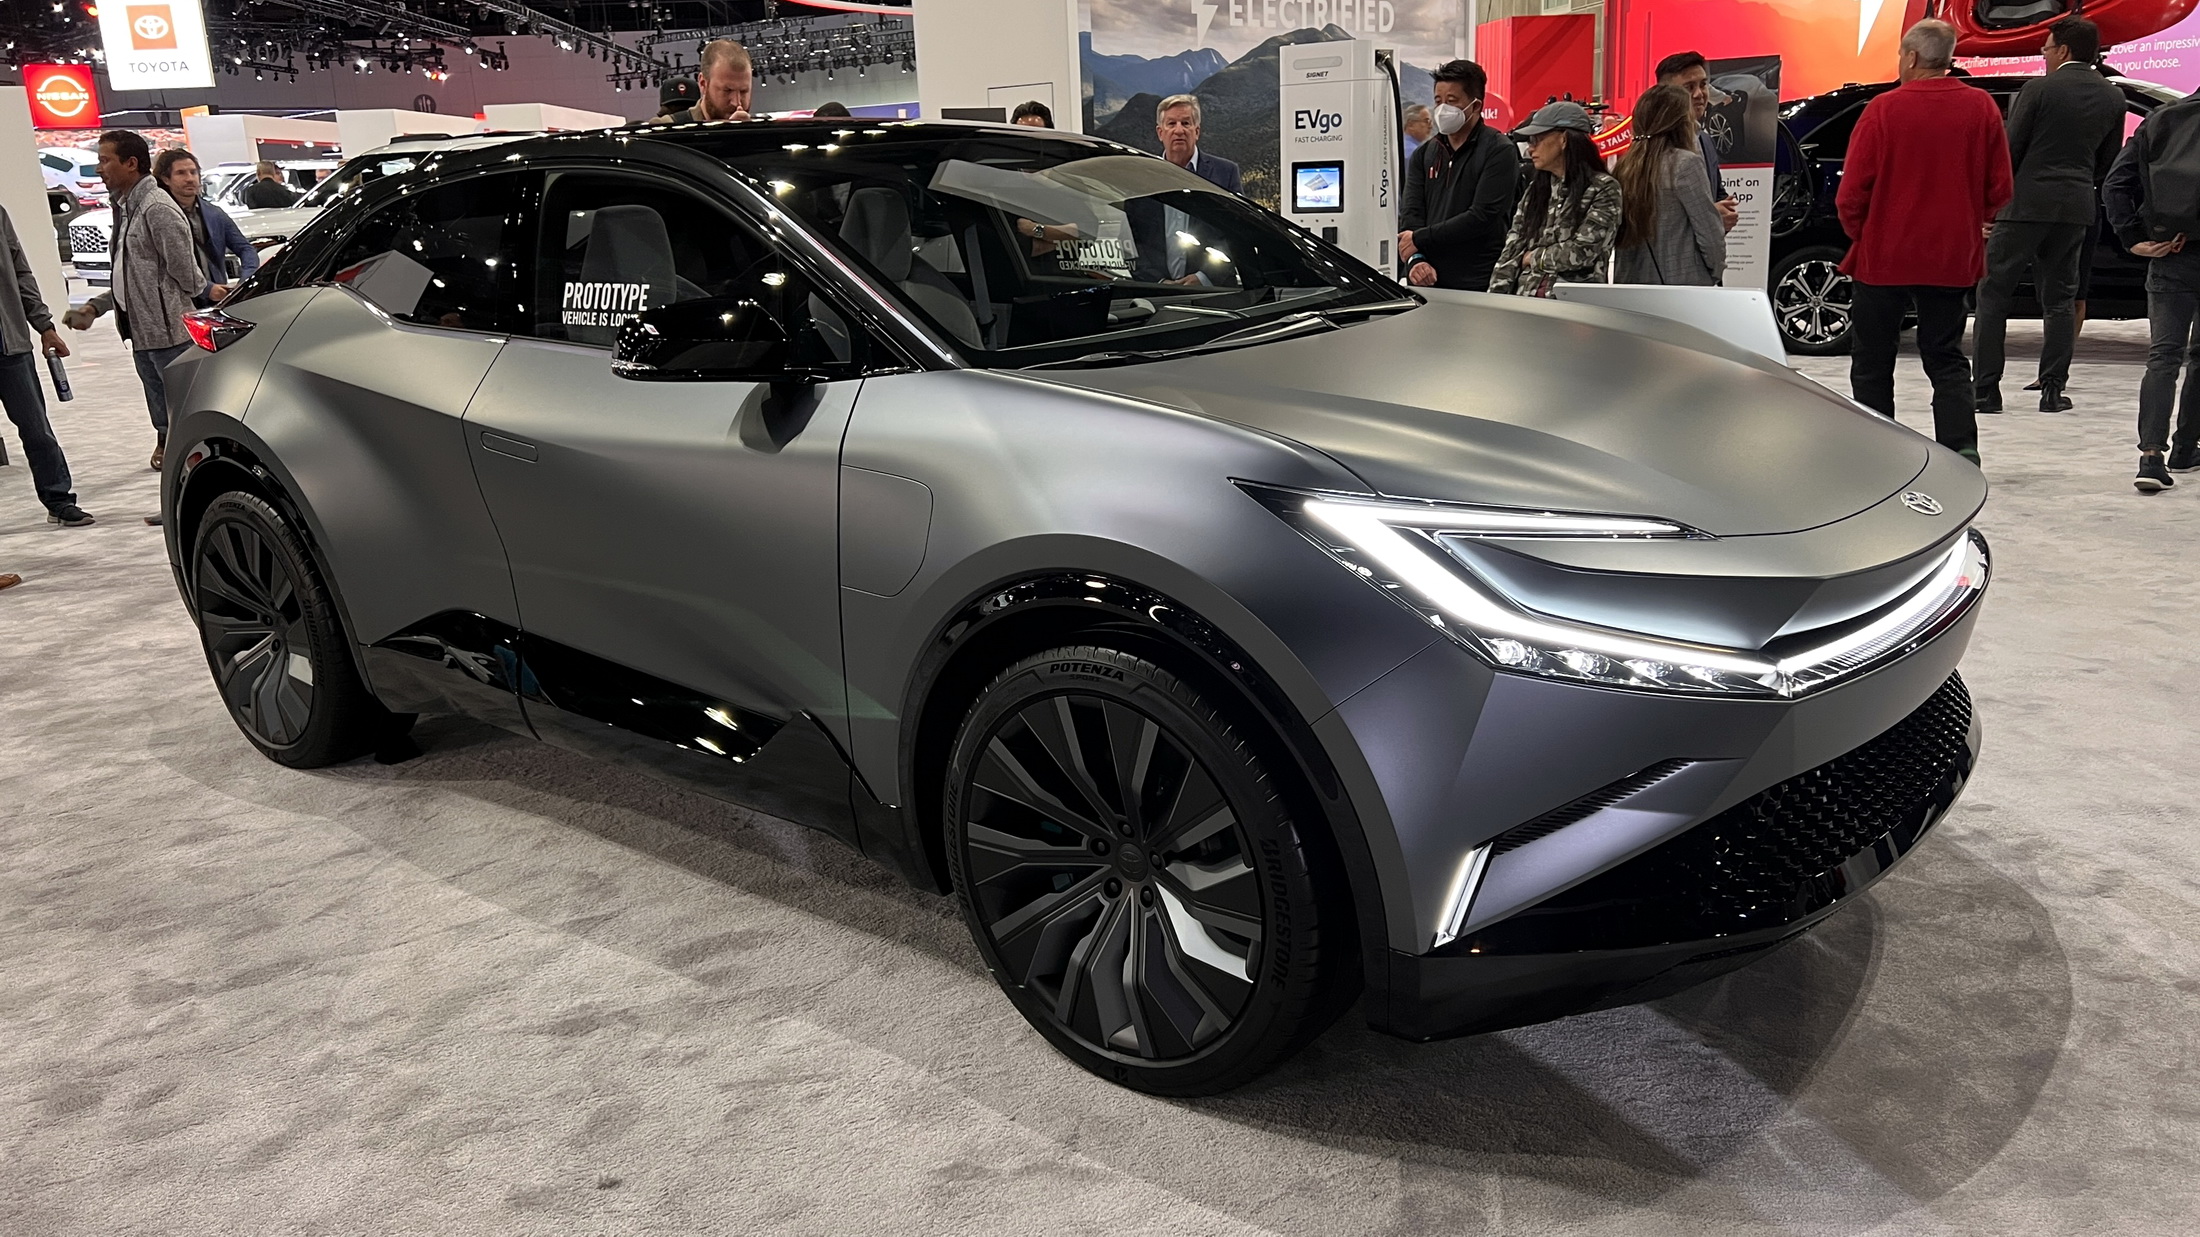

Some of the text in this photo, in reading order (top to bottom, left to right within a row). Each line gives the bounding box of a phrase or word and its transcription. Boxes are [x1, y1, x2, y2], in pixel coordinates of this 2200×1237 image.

[1229, 0, 1395, 33] ELECTRIFIED
[2139, 41, 2152, 52] an
[129, 61, 189, 73] TOYOTA
[2123, 60, 2141, 73] you
[2143, 57, 2181, 69] choose.
[37, 92, 89, 101] NISSAN
[1295, 109, 1343, 134] EVgo
[1310, 135, 1343, 143] CHARGING
[1606, 129, 1631, 147] TALK!
[1380, 169, 1389, 208] EVgo
[1732, 191, 1754, 203] App
[562, 282, 650, 312] PROTOTYPE
[562, 311, 597, 326] VEHICLE
[598, 312, 609, 327] IS
[1050, 662, 1125, 682] POTENZA
[1258, 838, 1292, 992] BRIDGESTONE
